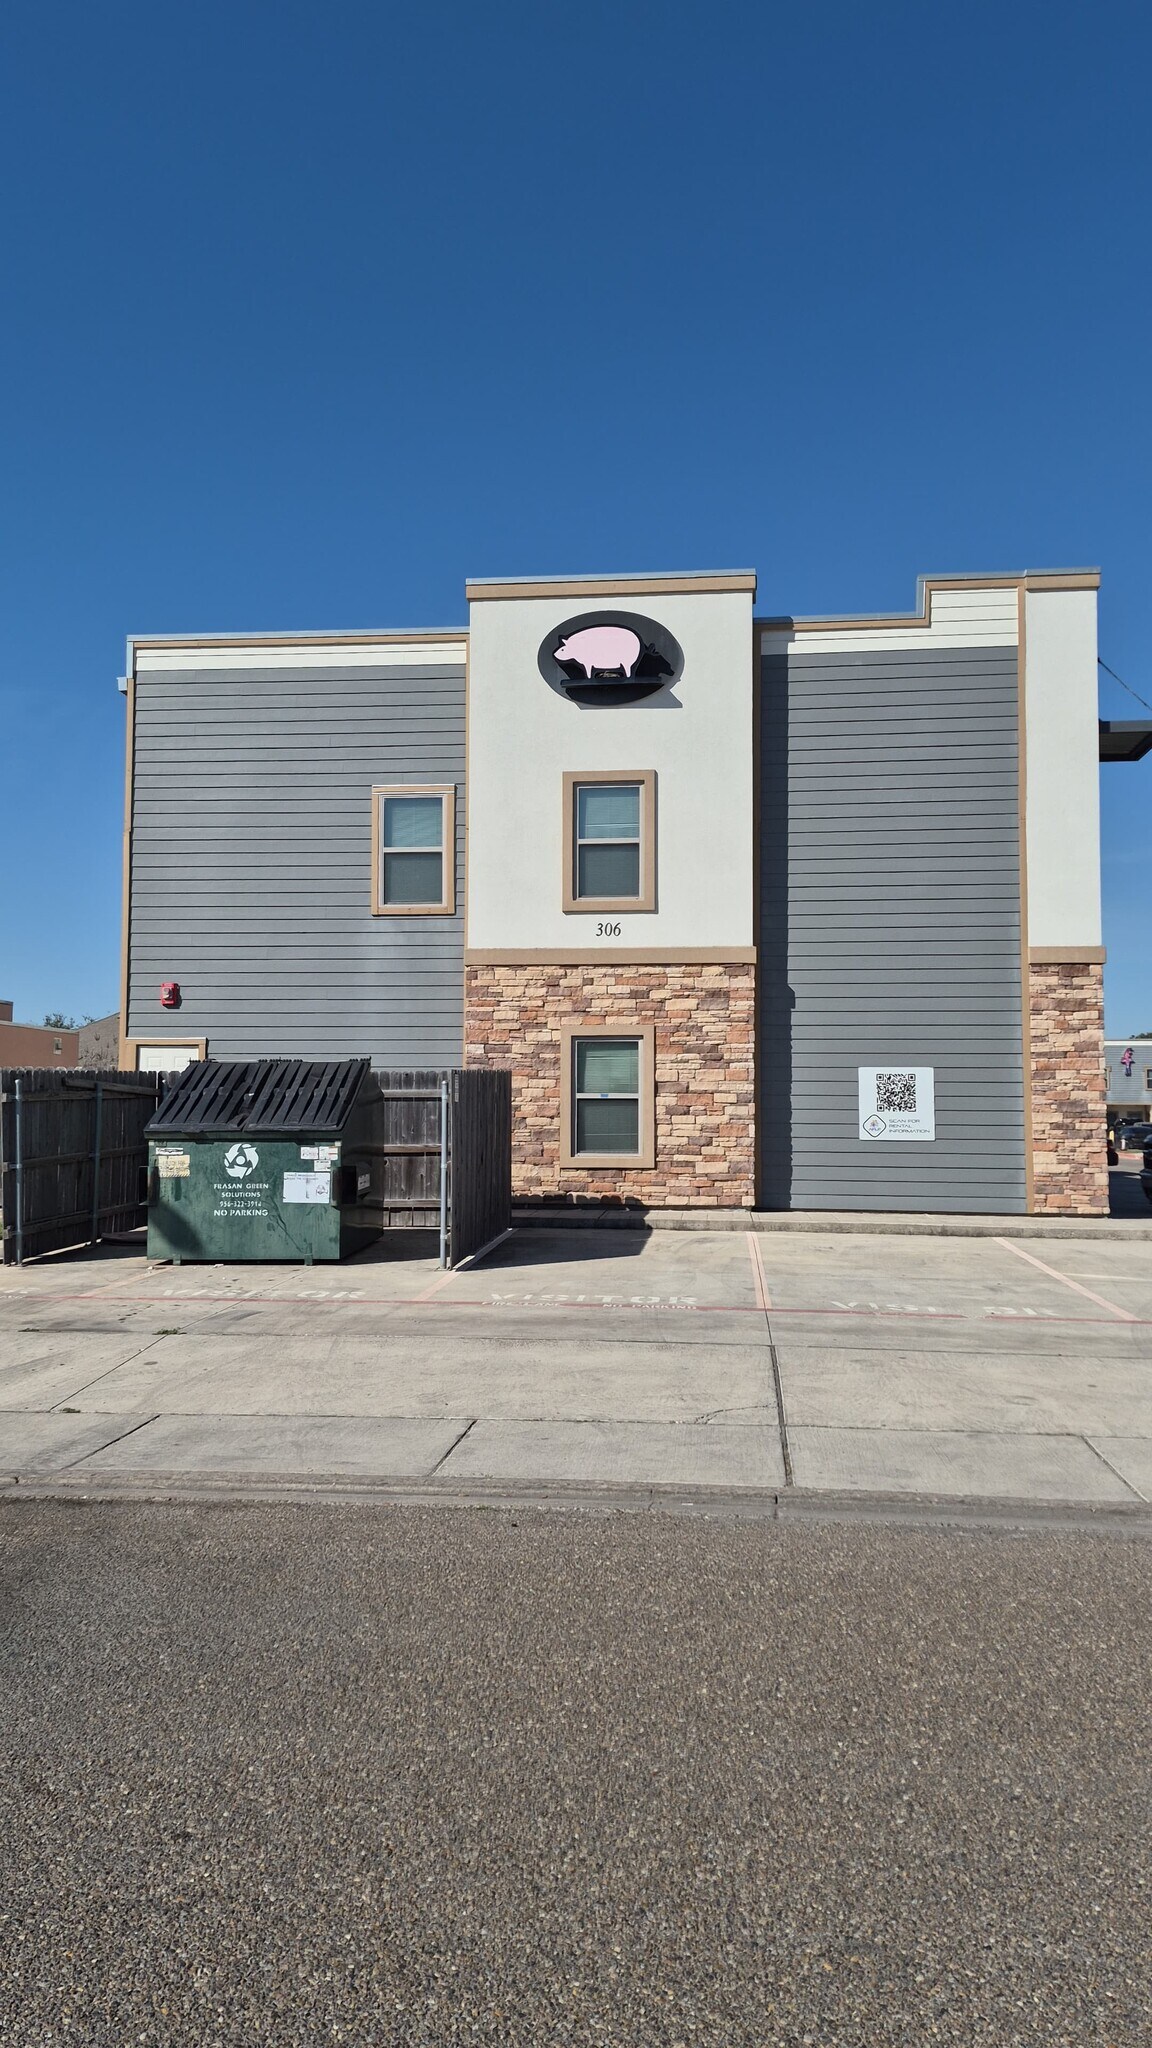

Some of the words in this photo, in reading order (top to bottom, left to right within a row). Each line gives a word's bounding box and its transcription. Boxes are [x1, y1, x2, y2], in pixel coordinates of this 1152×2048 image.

[595, 922, 621, 937] 306
[491, 1293, 698, 1305] VISITOR
[831, 1301, 1060, 1316] VISIOR
